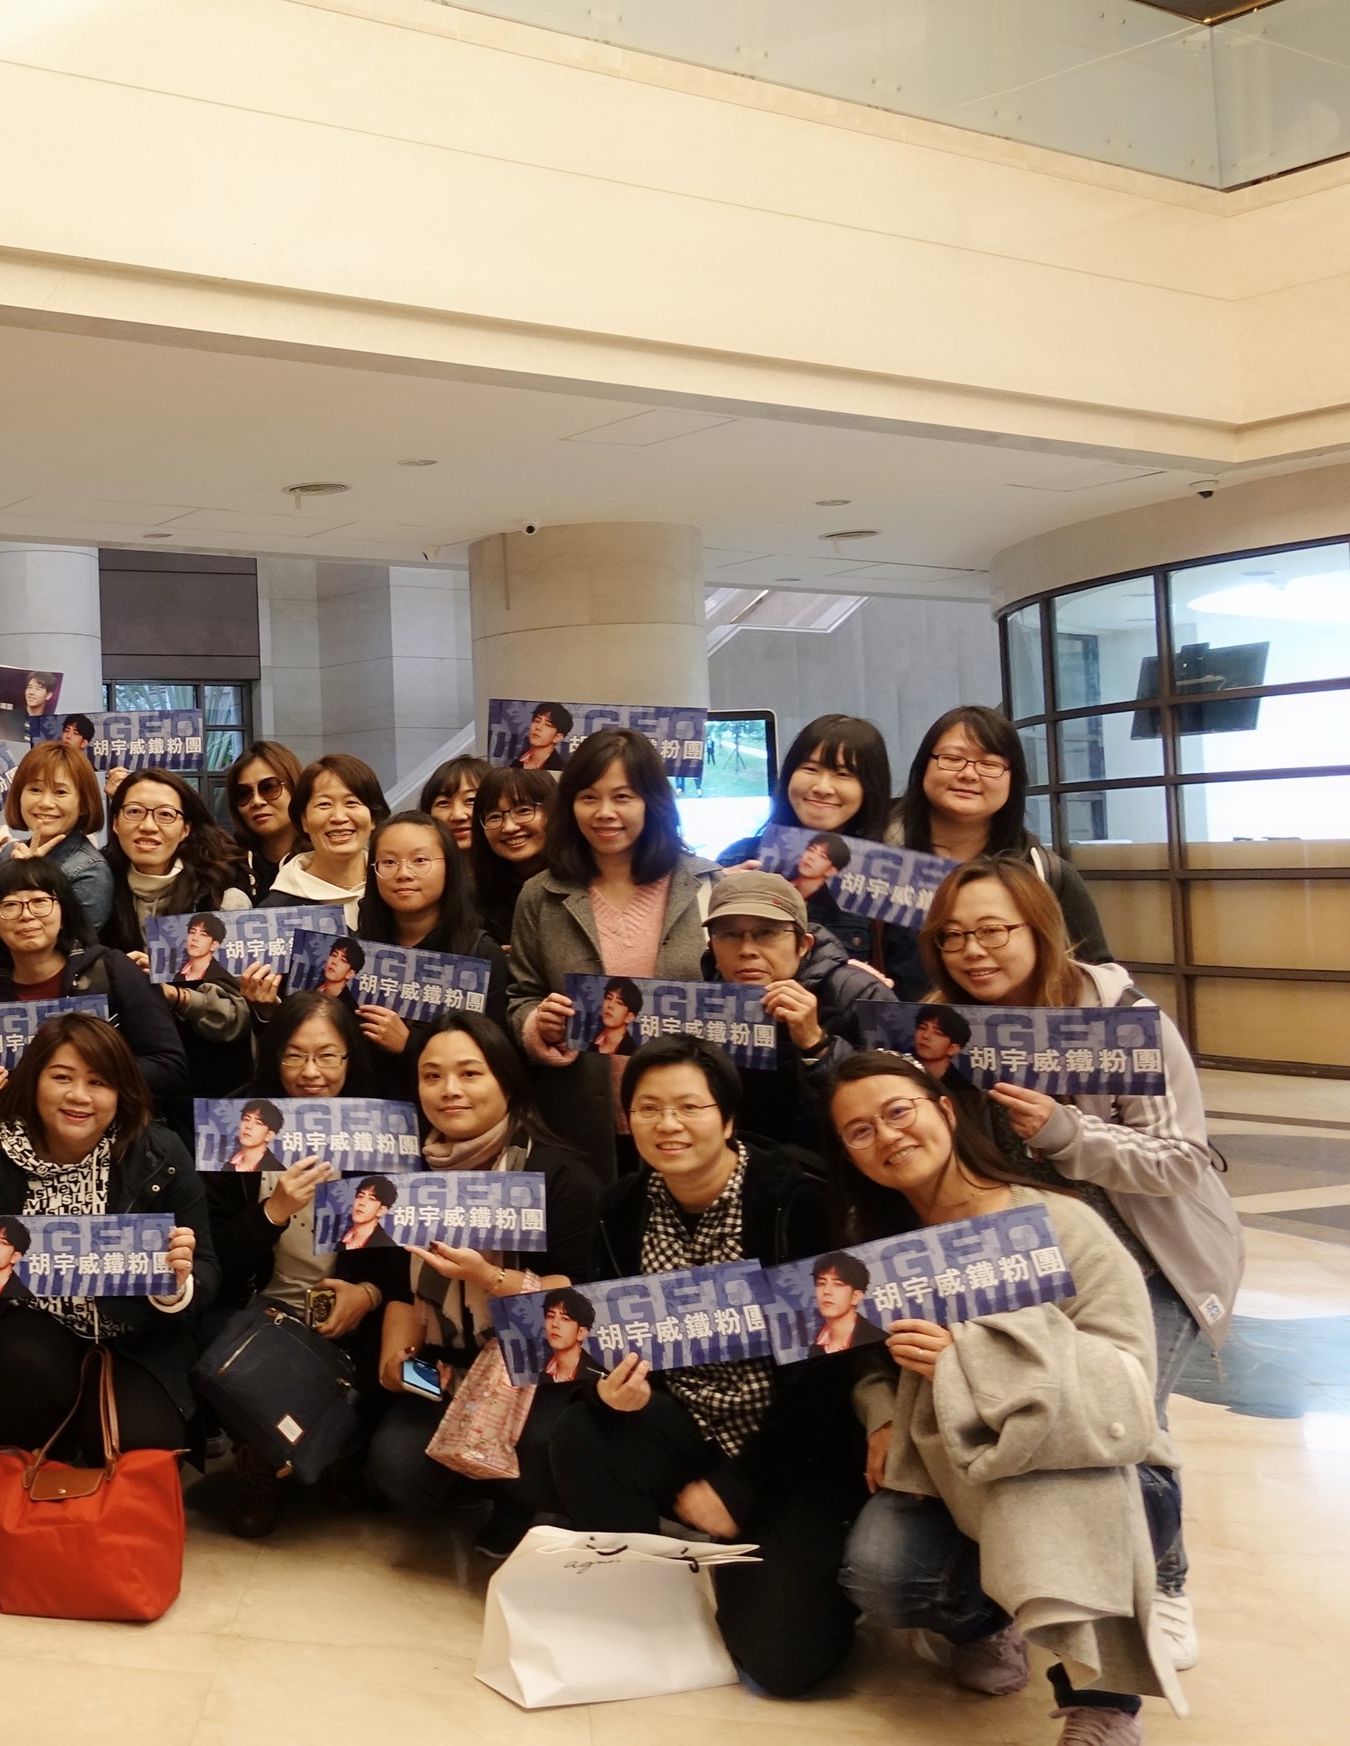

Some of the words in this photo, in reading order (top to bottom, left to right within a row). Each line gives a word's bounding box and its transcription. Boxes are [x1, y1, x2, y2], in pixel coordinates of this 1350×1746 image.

[93, 736, 202, 756] 胡宇威鐵粉團
[358, 973, 487, 1014] 胡宇威鐵粉團
[639, 1015, 776, 1049] 胡宇威鐵粉團
[969, 1046, 1163, 1074] 胡宇威鐵粉團
[281, 1131, 421, 1157] 胡宇威鐵粉團
[393, 1205, 546, 1232] 胡宇威鐵粉團
[28, 1252, 175, 1276] 胡宇威鐵粉團
[872, 1246, 1067, 1312] 胡宇威鐵粉團
[596, 1303, 767, 1350] 胡宇威鐵粉團
